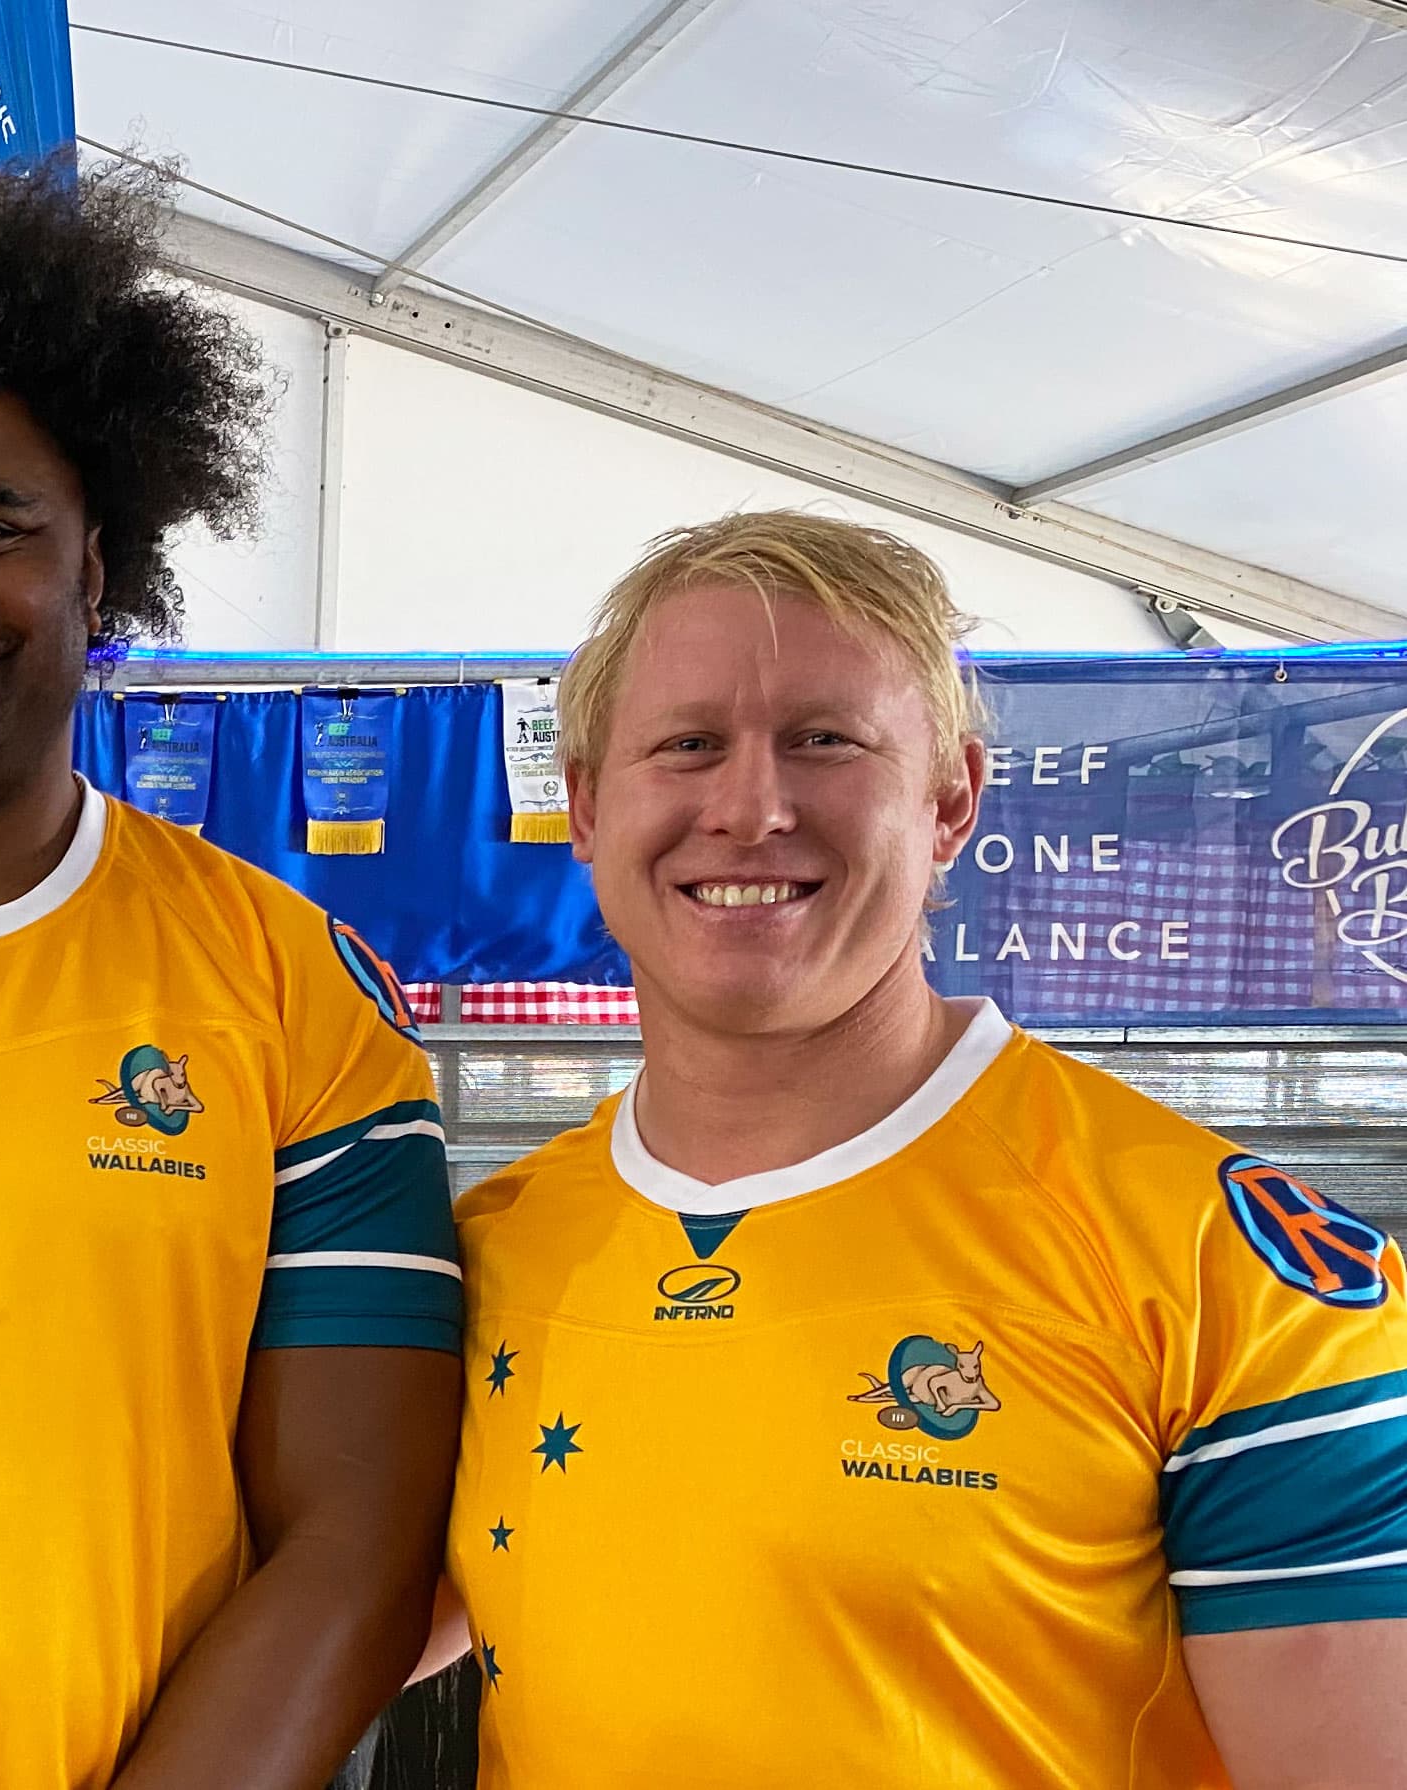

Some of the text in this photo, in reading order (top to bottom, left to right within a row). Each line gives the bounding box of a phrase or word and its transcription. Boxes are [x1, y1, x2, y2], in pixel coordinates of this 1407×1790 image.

[985, 745, 1109, 786] EEF
[944, 833, 1121, 874] ONE
[86, 1135, 167, 1155] CLASSIC
[87, 1153, 206, 1180] WALLABIES
[653, 1304, 734, 1321] INFERNO
[840, 1440, 941, 1464] CLASSIC
[841, 1459, 999, 1491] WALLABIES
